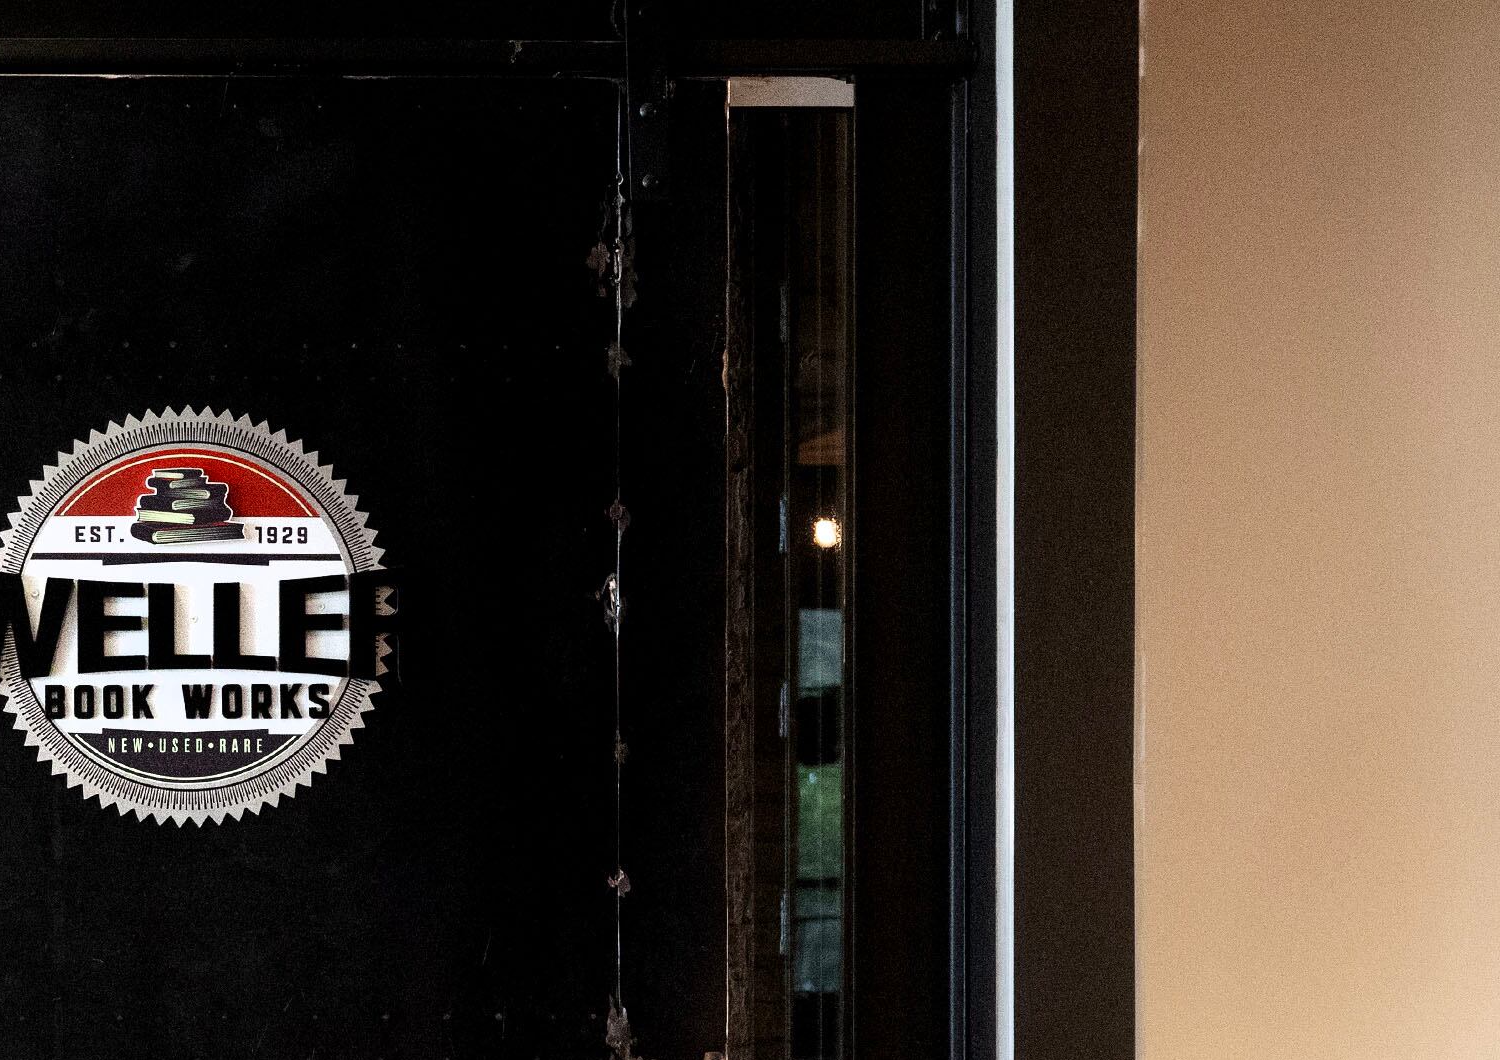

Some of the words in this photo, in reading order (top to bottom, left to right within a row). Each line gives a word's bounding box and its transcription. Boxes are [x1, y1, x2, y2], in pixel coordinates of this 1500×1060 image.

[74, 525, 125, 544] EST.
[254, 526, 309, 545] 1929
[44, 684, 156, 720] BOOK
[181, 683, 331, 720] WORKS
